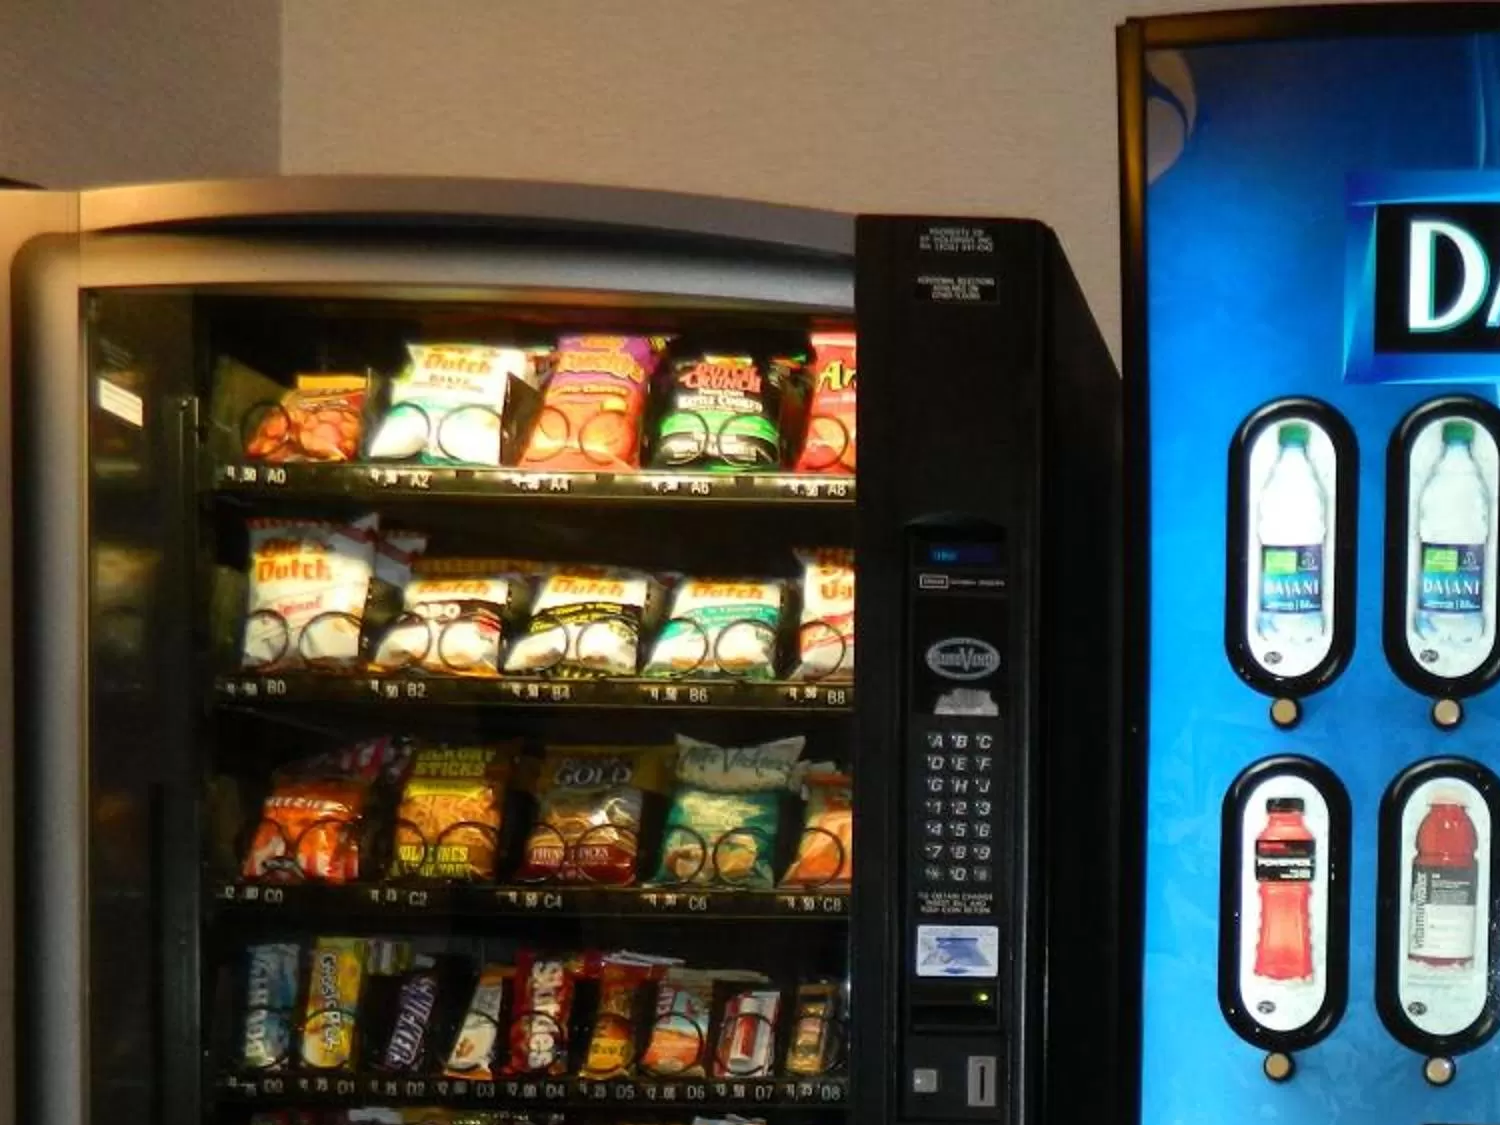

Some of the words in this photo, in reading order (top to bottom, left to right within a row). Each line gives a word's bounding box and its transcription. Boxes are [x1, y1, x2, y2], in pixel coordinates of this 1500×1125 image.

[256, 557, 333, 582] Dutch
[1264, 578, 1320, 595] DASANI
[1423, 579, 1480, 596] DASANI
